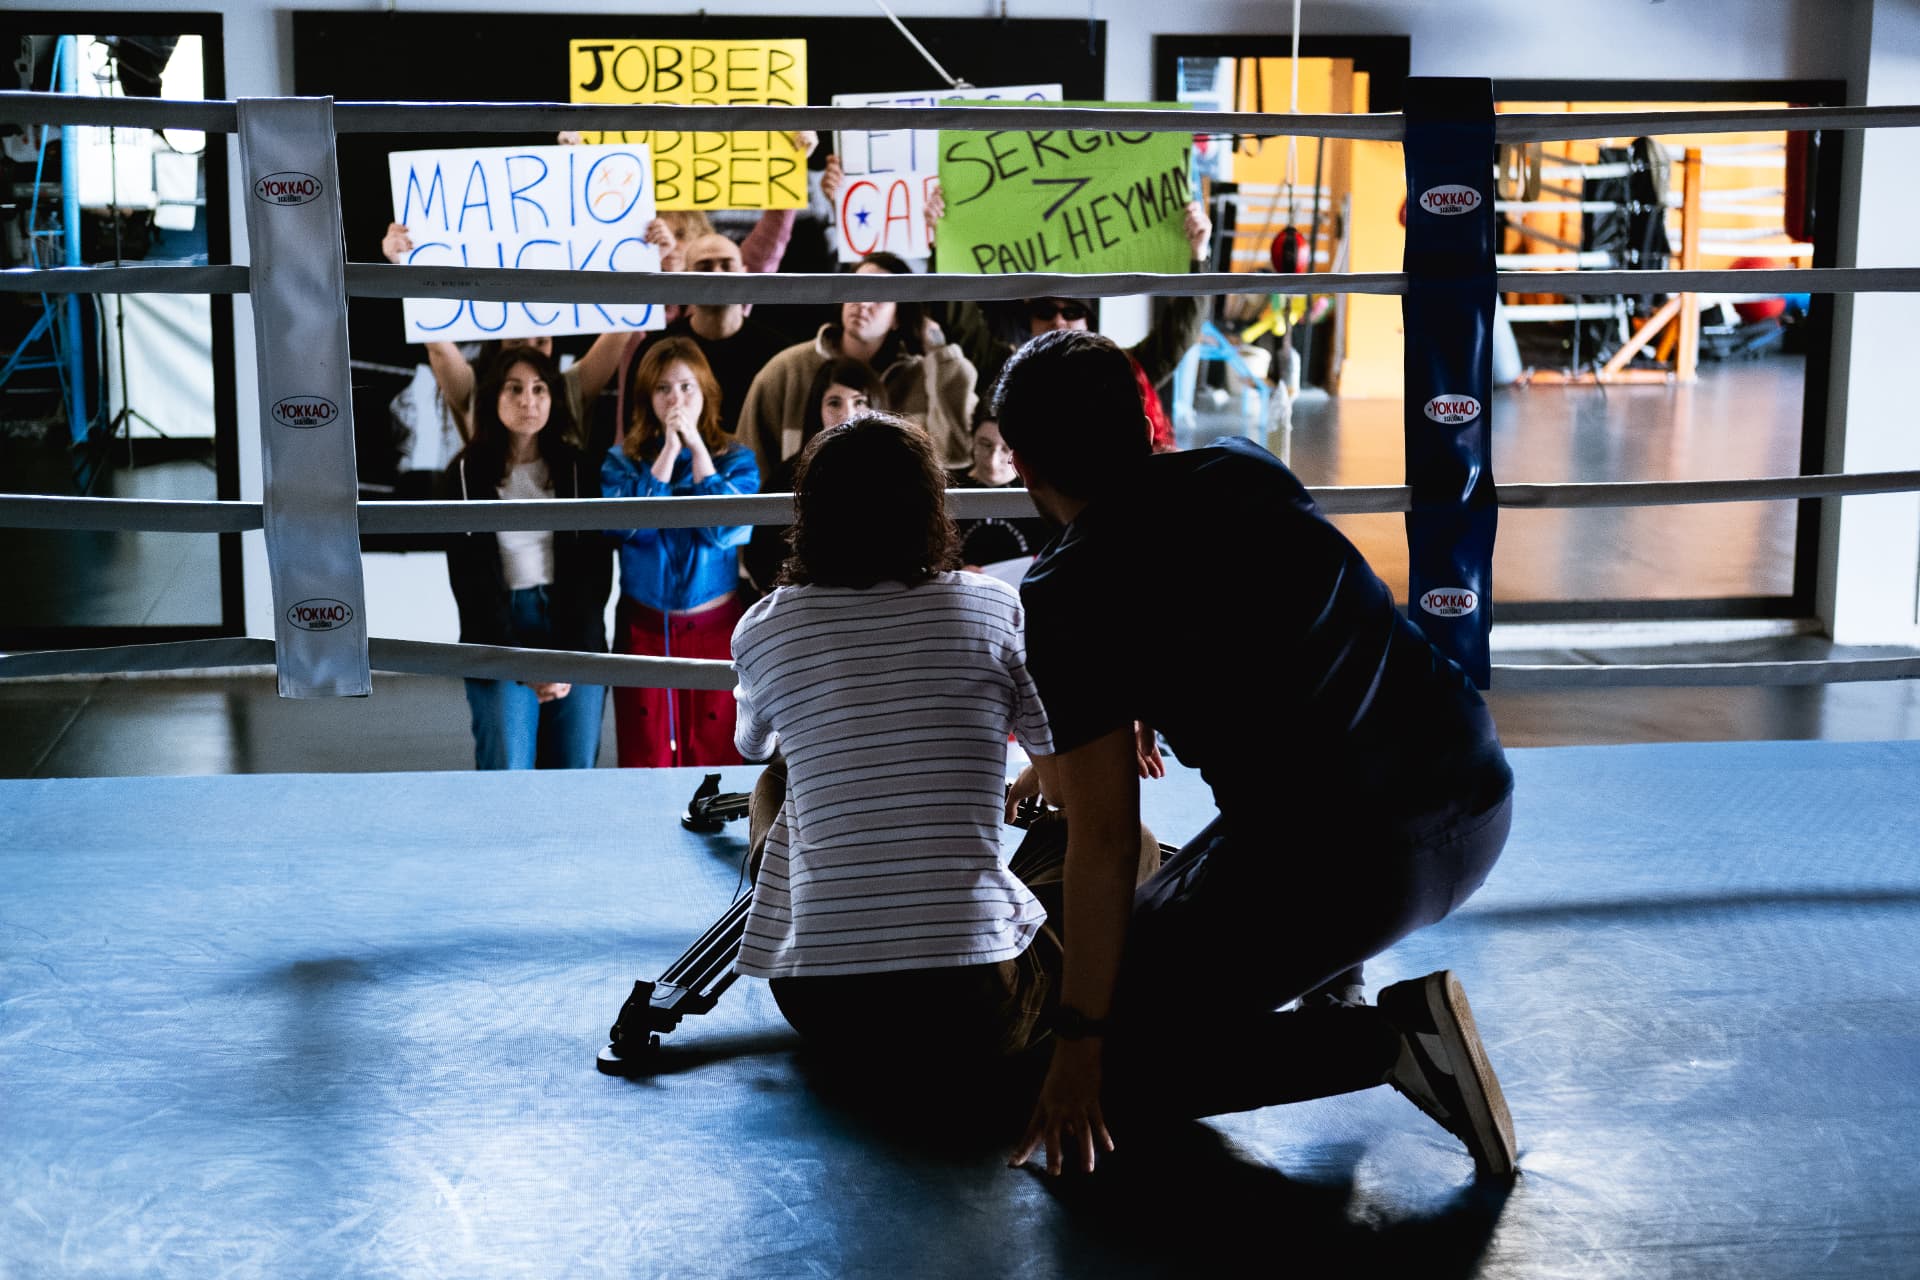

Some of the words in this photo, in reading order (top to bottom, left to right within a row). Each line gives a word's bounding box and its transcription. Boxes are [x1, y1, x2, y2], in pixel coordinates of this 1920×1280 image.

[577, 45, 796, 93] JOBBER
[263, 179, 315, 197] YOKKAO
[654, 157, 801, 207] BBER
[402, 152, 645, 233] MARIO
[1427, 191, 1475, 207] YOKKAO
[972, 231, 1062, 274] PAUL
[1062, 147, 1192, 260] HEYMAN
[408, 237, 657, 333] SUCKS
[280, 403, 330, 419] YOKKAO
[1431, 400, 1475, 416] YOKKAO
[1427, 594, 1473, 608] YOKKAO
[295, 605, 345, 622] YOKKAO
